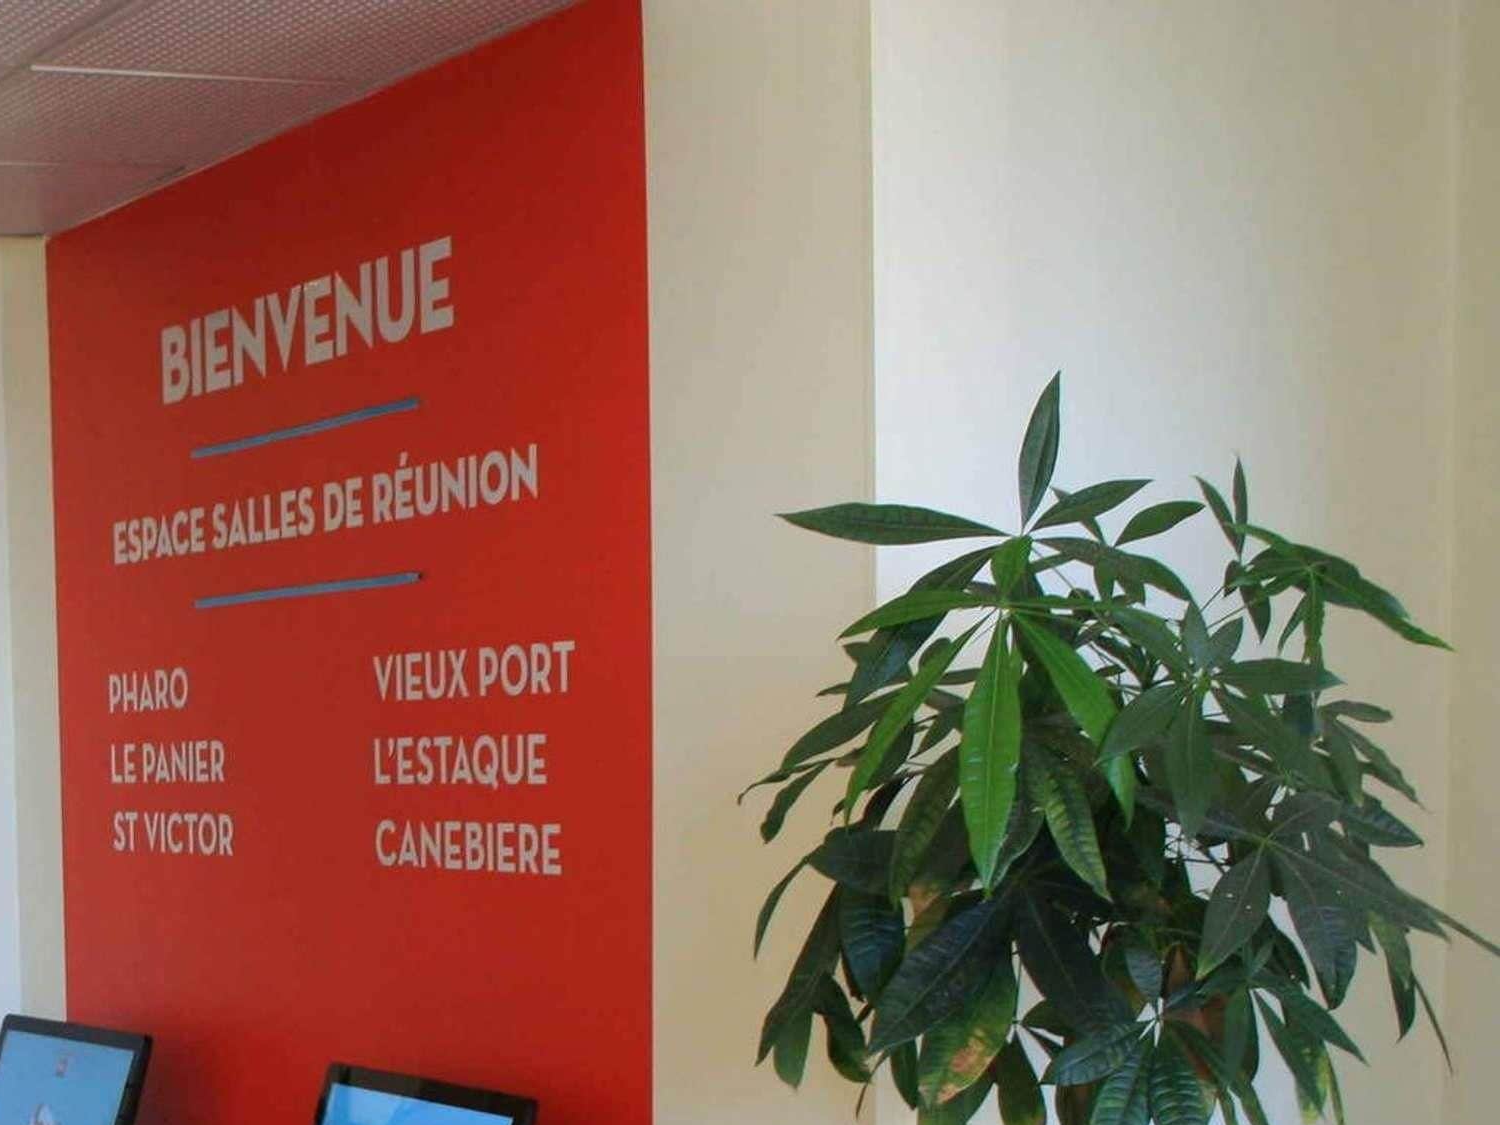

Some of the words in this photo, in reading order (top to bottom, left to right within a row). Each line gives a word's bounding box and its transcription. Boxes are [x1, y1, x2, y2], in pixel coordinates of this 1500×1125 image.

[162, 236, 454, 404] BIENVENUE
[113, 507, 206, 565] ESPACE
[212, 486, 315, 550] SALLES
[323, 477, 364, 532] DE
[372, 443, 538, 524] RÉUNION
[108, 668, 189, 714] PHARO
[373, 650, 469, 702] VIEUX
[478, 640, 576, 698] PORT
[110, 743, 137, 784] LE
[142, 740, 225, 784] PANIER
[374, 733, 547, 790] L'ESTAQUE
[113, 810, 139, 853] ST
[143, 811, 234, 857] VICTOR
[375, 819, 562, 876] CANEBIERE
